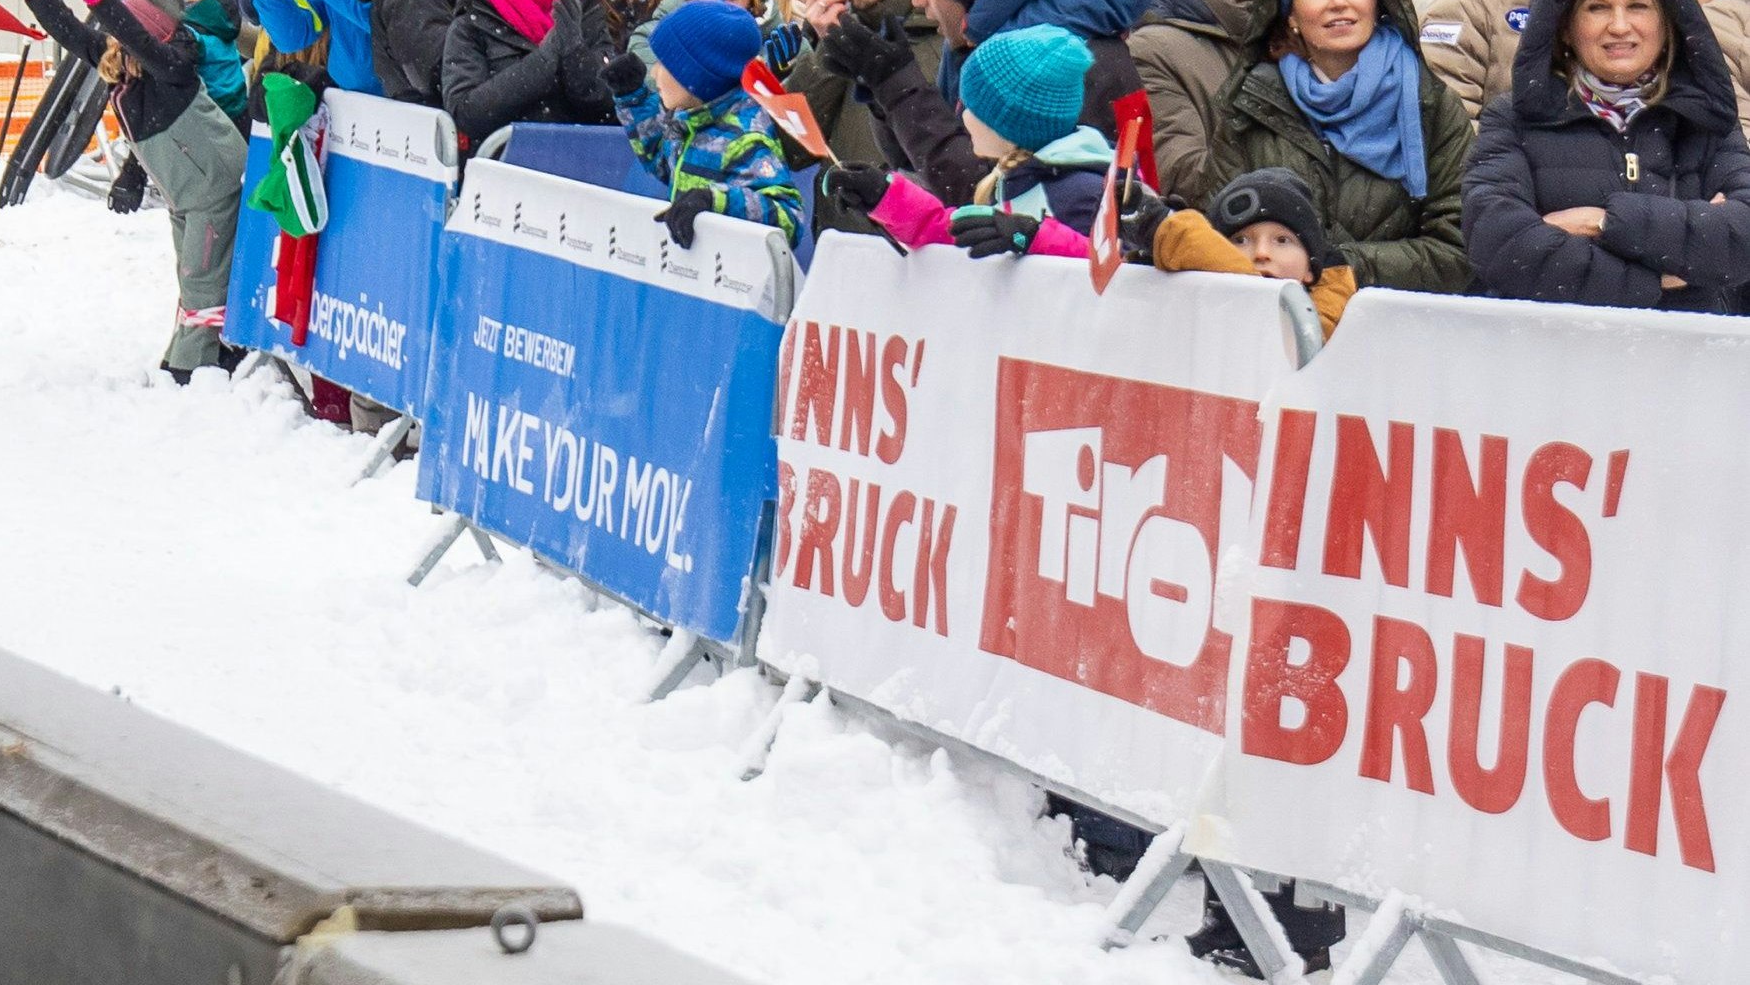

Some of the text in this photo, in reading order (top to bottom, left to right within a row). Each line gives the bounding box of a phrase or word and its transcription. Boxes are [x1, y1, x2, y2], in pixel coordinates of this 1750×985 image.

[308, 278, 407, 370] berspächer
[463, 392, 534, 495] MAKE
[544, 420, 618, 535] YOUR
[1022, 426, 1254, 668] Tirol
[1259, 407, 1631, 622] INNS'
[1241, 596, 1728, 874] BRUCK
